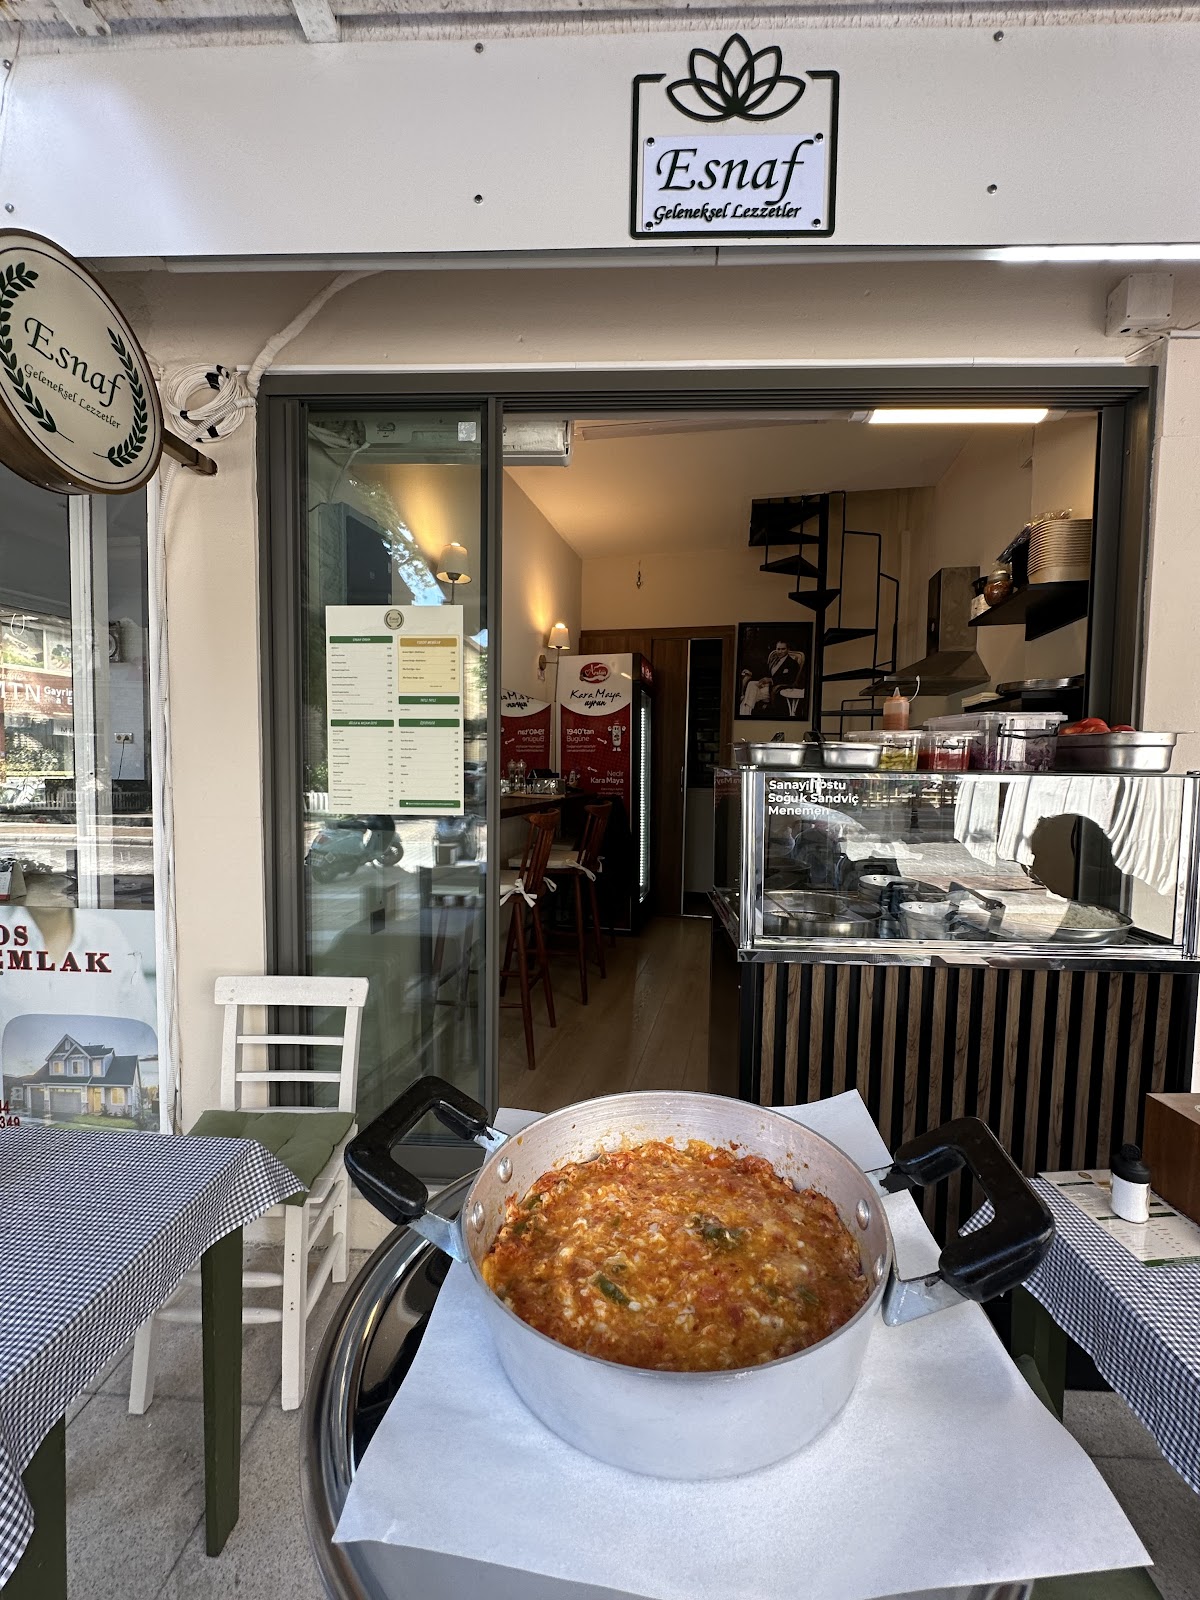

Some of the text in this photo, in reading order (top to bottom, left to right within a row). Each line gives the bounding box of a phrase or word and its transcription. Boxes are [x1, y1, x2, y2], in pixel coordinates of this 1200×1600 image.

[655, 139, 814, 206] Esnaf
[653, 201, 802, 224] Geleneksel Lezzetler
[24, 317, 126, 407] Esnaf
[23, 363, 121, 429] Geleneksel Lezzetler
[570, 689, 622, 702] Kara Maya
[606, 777, 624, 785] Maya
[769, 780, 810, 792] Sanayi
[768, 792, 859, 806] Soğuk Sandviç
[768, 806, 830, 815] Menemen
[0, 950, 112, 973] MLAK
